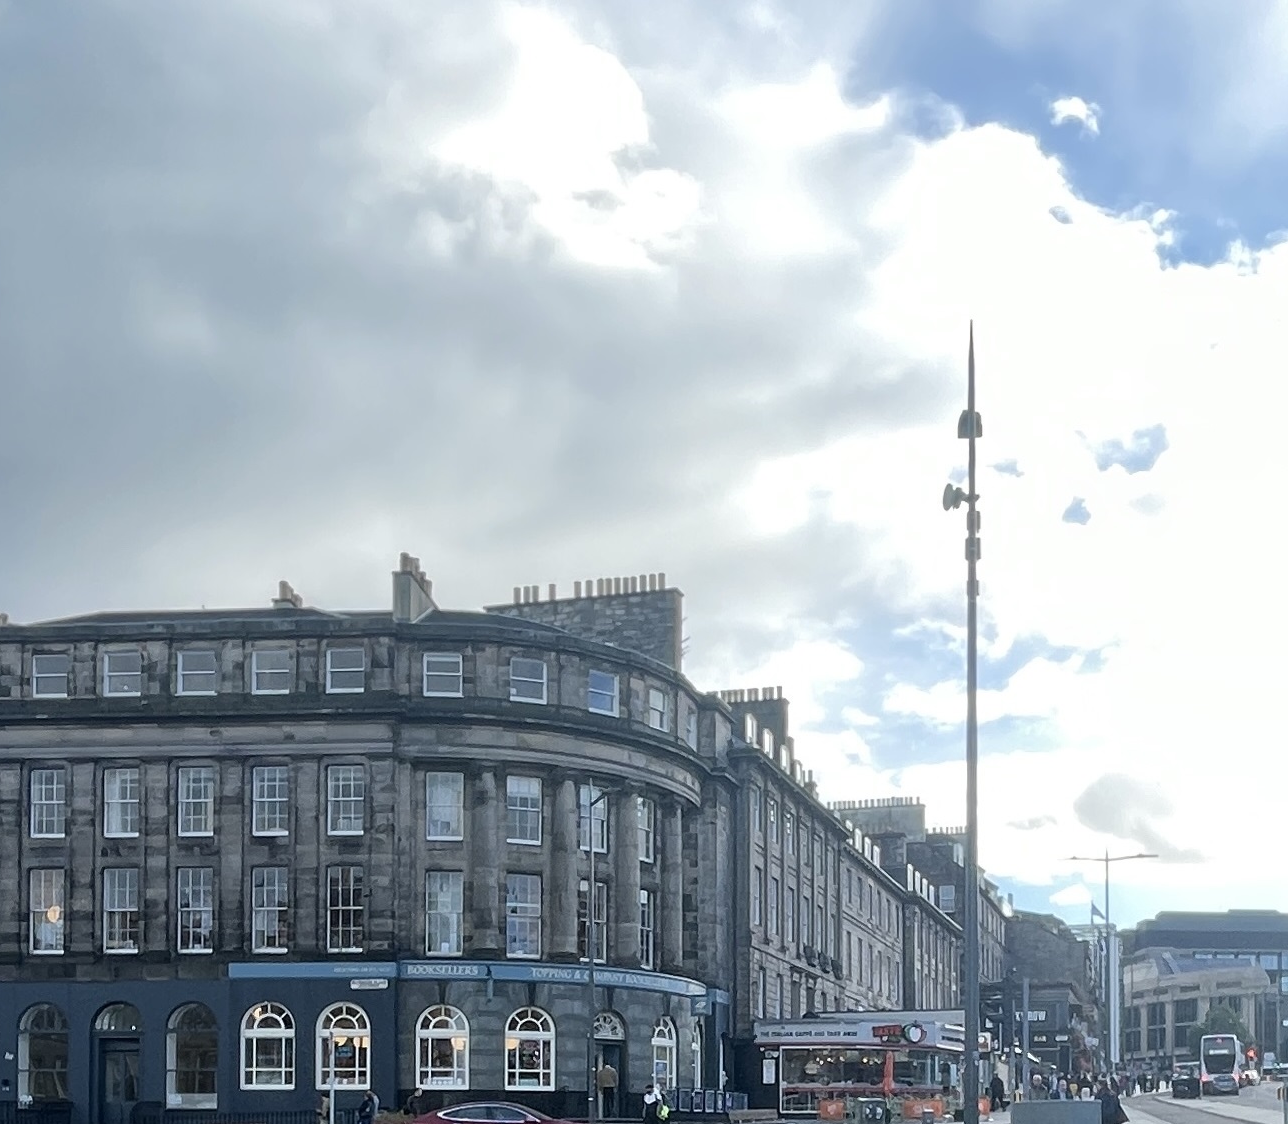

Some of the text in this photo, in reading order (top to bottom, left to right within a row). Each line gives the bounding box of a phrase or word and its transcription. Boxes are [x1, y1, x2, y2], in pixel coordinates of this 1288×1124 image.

[407, 964, 479, 977] BOOKSELLERS
[531, 966, 573, 980] TOPPING
[573, 970, 581, 981] &
[583, 970, 625, 984] CMPANY
